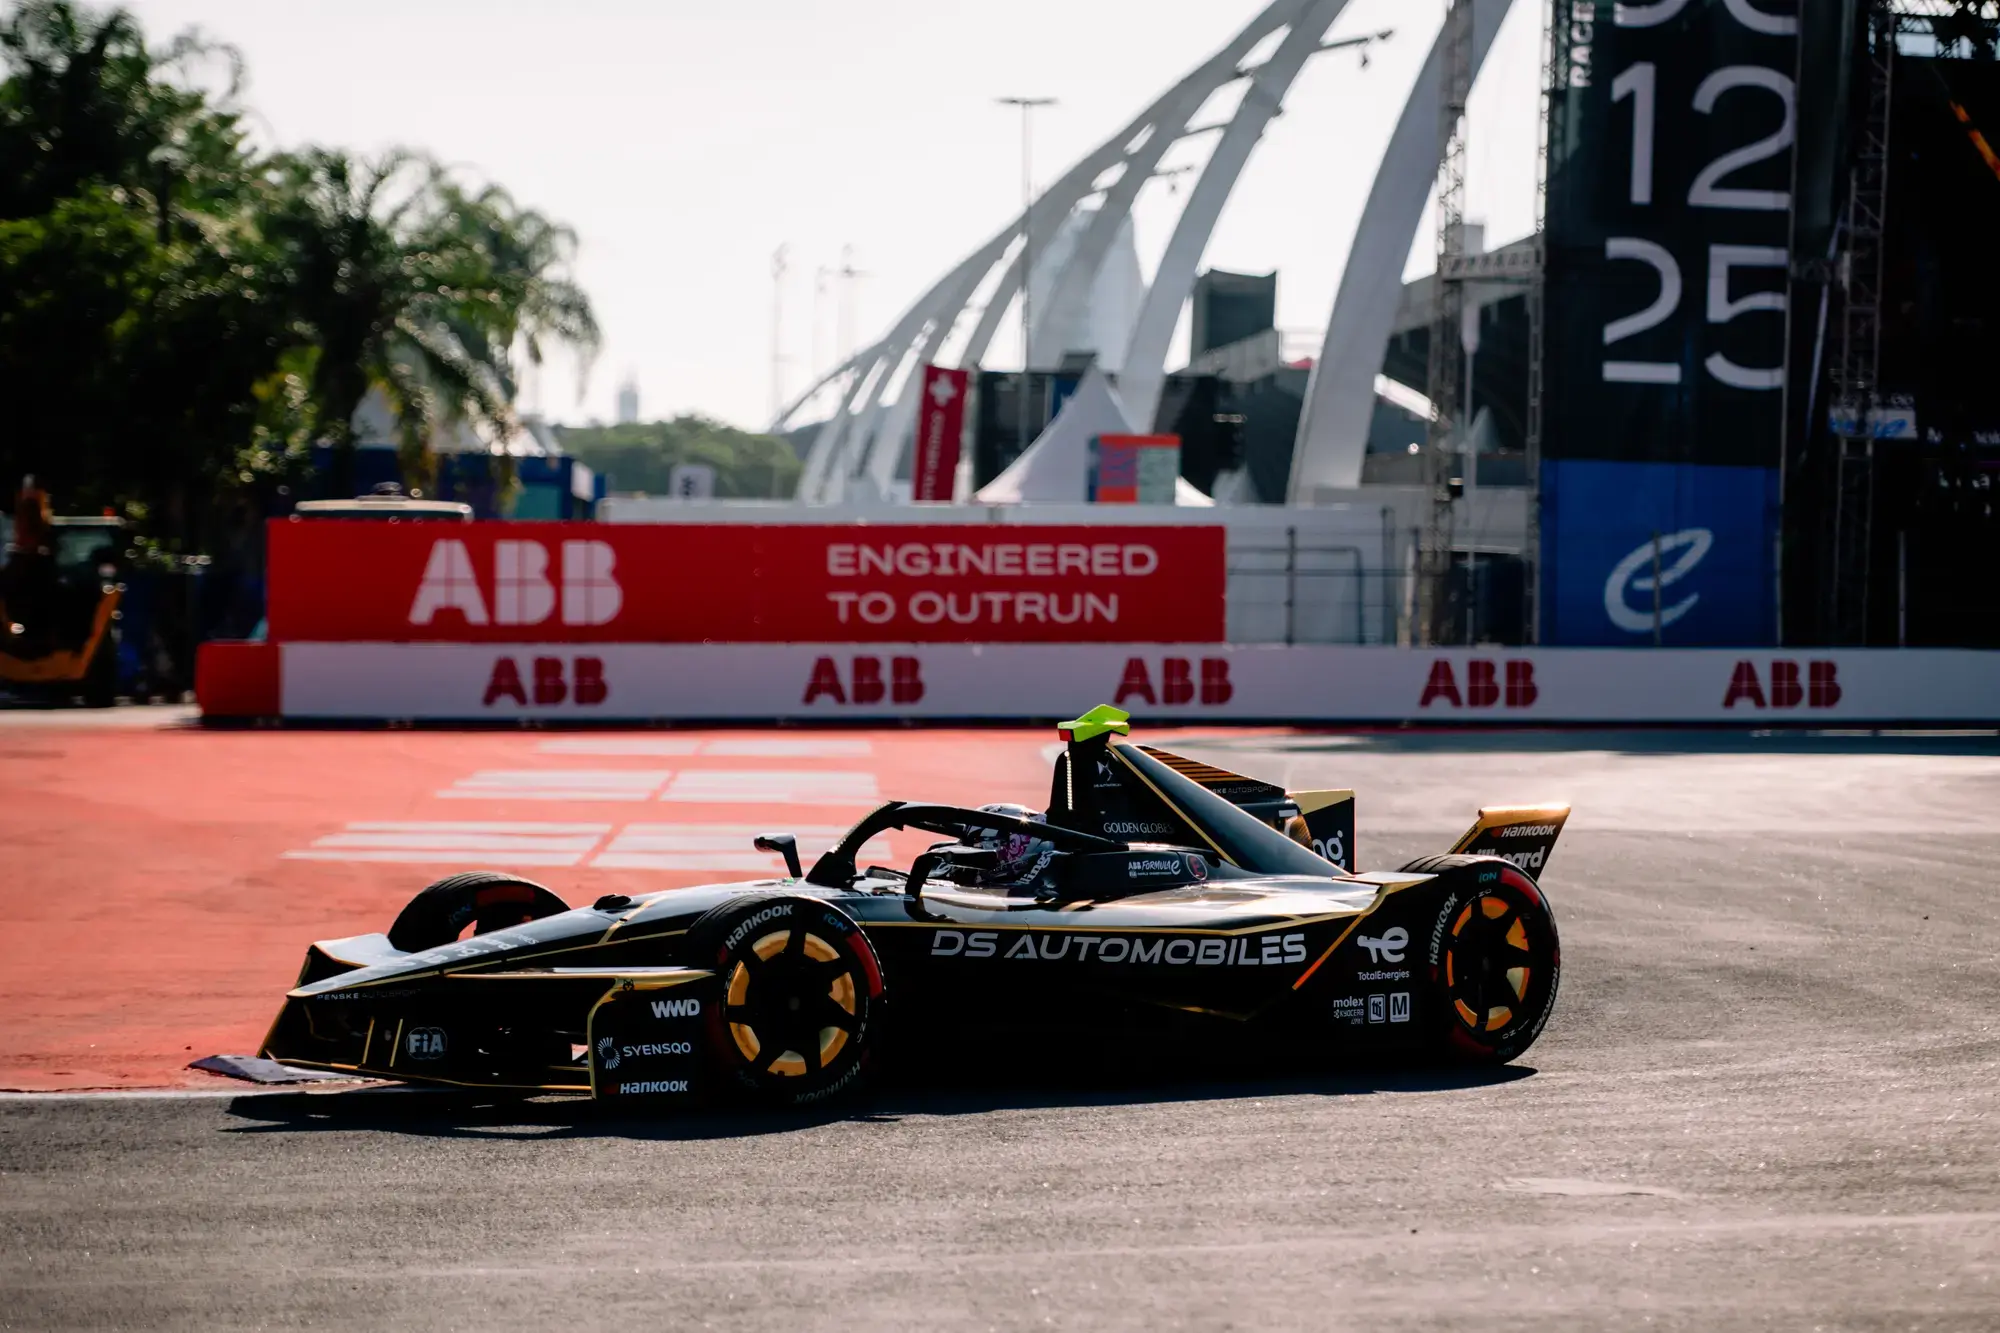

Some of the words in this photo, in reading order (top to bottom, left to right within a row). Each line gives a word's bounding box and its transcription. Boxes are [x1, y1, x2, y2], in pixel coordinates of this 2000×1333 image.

[1611, 61, 1797, 210] 12
[1602, 237, 1790, 389] 25
[827, 544, 1159, 576] ENGINEERED
[408, 539, 623, 626] ABB
[827, 592, 896, 624] TO
[908, 592, 1119, 624] OUTRUN
[482, 657, 608, 707] ABB
[802, 657, 925, 706] ABB
[1115, 657, 1233, 706] ABB
[1419, 659, 1539, 707] ABB
[1722, 659, 1842, 707] ABB
[1228, 786, 1272, 794] AUTOSPORT
[1103, 822, 1139, 834] GOLDEN
[1142, 859, 1171, 871] FORMULA
[931, 930, 999, 957] DS
[1003, 933, 1307, 966] AUTOMOBILES
[1357, 969, 1410, 981] TotalEnergies
[317, 992, 359, 1001] PENSKE
[650, 998, 701, 1019] WWD
[1333, 995, 1364, 1008] molex
[622, 1042, 692, 1057] SYENSQO
